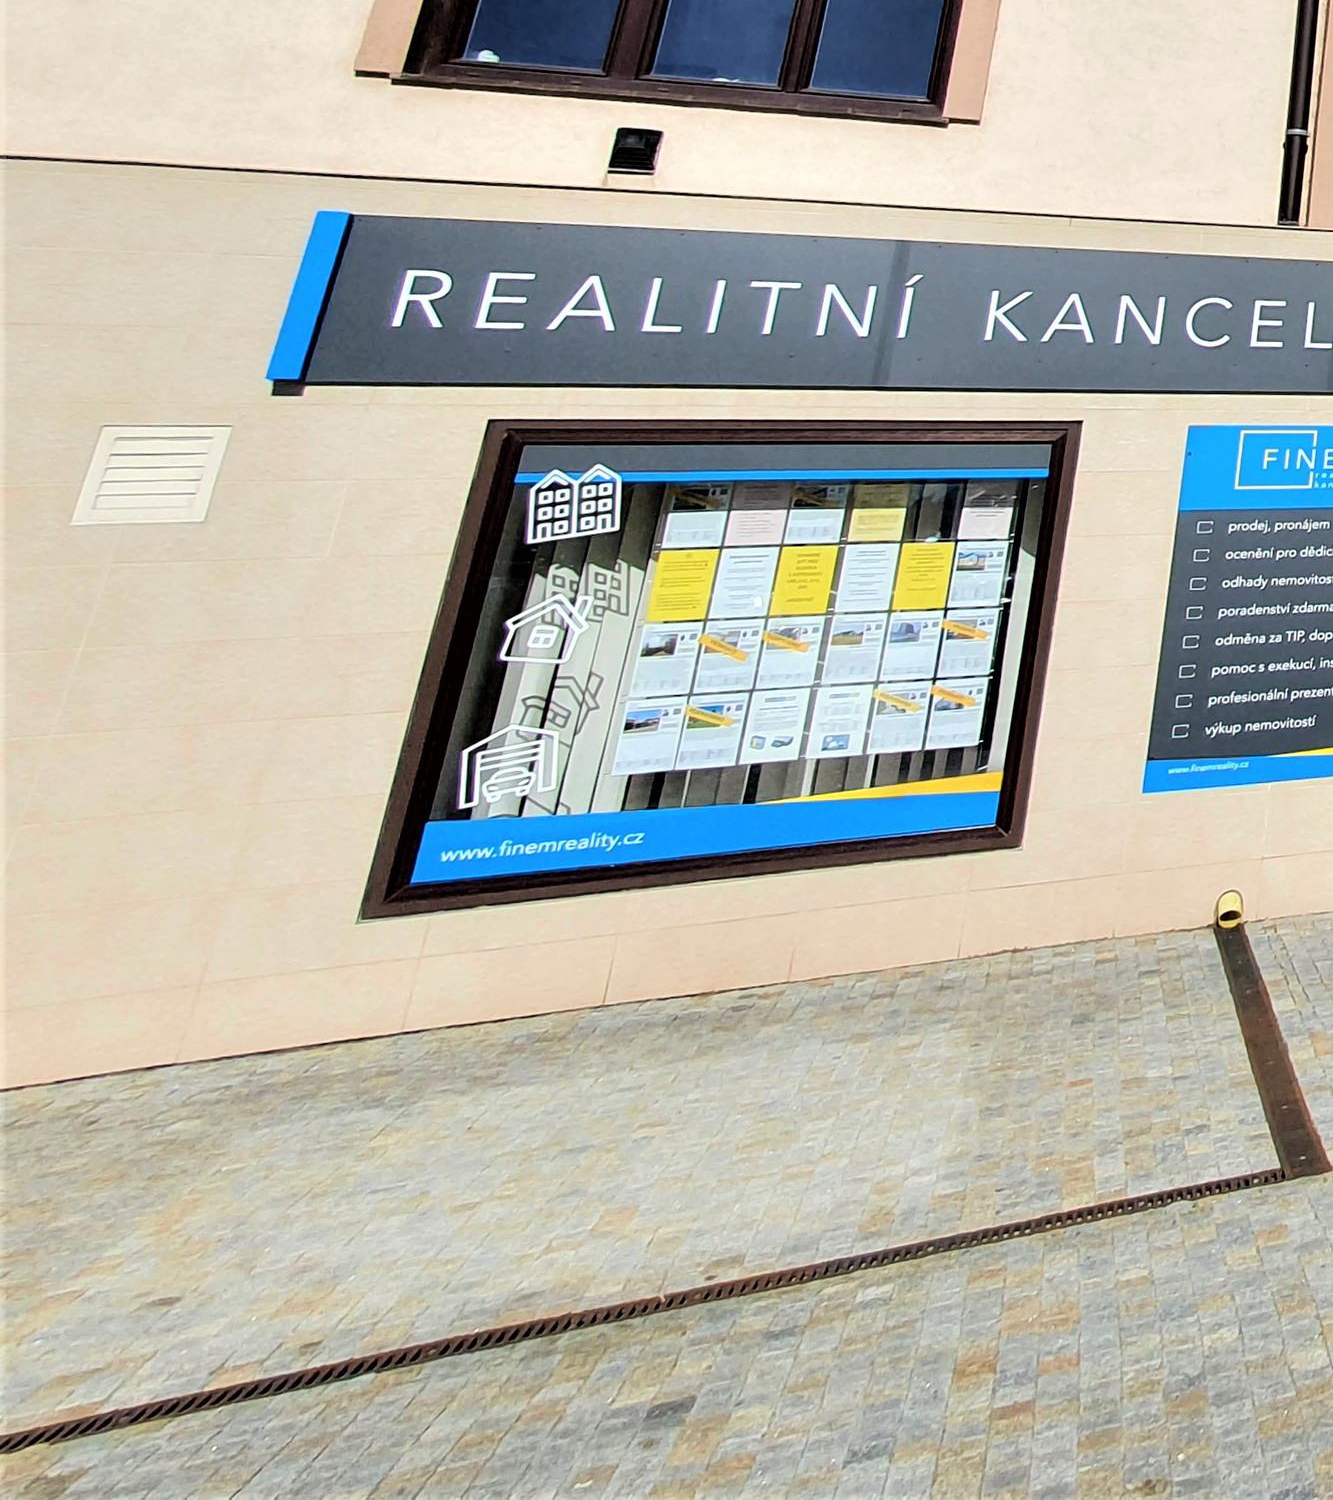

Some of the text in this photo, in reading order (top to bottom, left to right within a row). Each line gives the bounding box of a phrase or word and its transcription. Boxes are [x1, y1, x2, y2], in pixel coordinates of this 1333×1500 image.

[390, 268, 925, 340] REALITNÍ
[1228, 518, 1331, 534] prodej, pronájem
[1225, 547, 1274, 560] ocenění
[1275, 549, 1297, 561] pro
[1221, 575, 1269, 590] odhady
[1217, 602, 1291, 620] poradenství
[1215, 633, 1266, 647] odměna
[1268, 634, 1282, 644] za
[1285, 630, 1306, 644] TIP,
[1211, 664, 1256, 678] pomoc
[1258, 664, 1265, 673] s
[1267, 657, 1316, 672] exekucí,
[1208, 688, 1289, 708] profesionální
[1204, 715, 1318, 739] výkup nemovitostí
[441, 832, 646, 862] www.finemreality.cz
